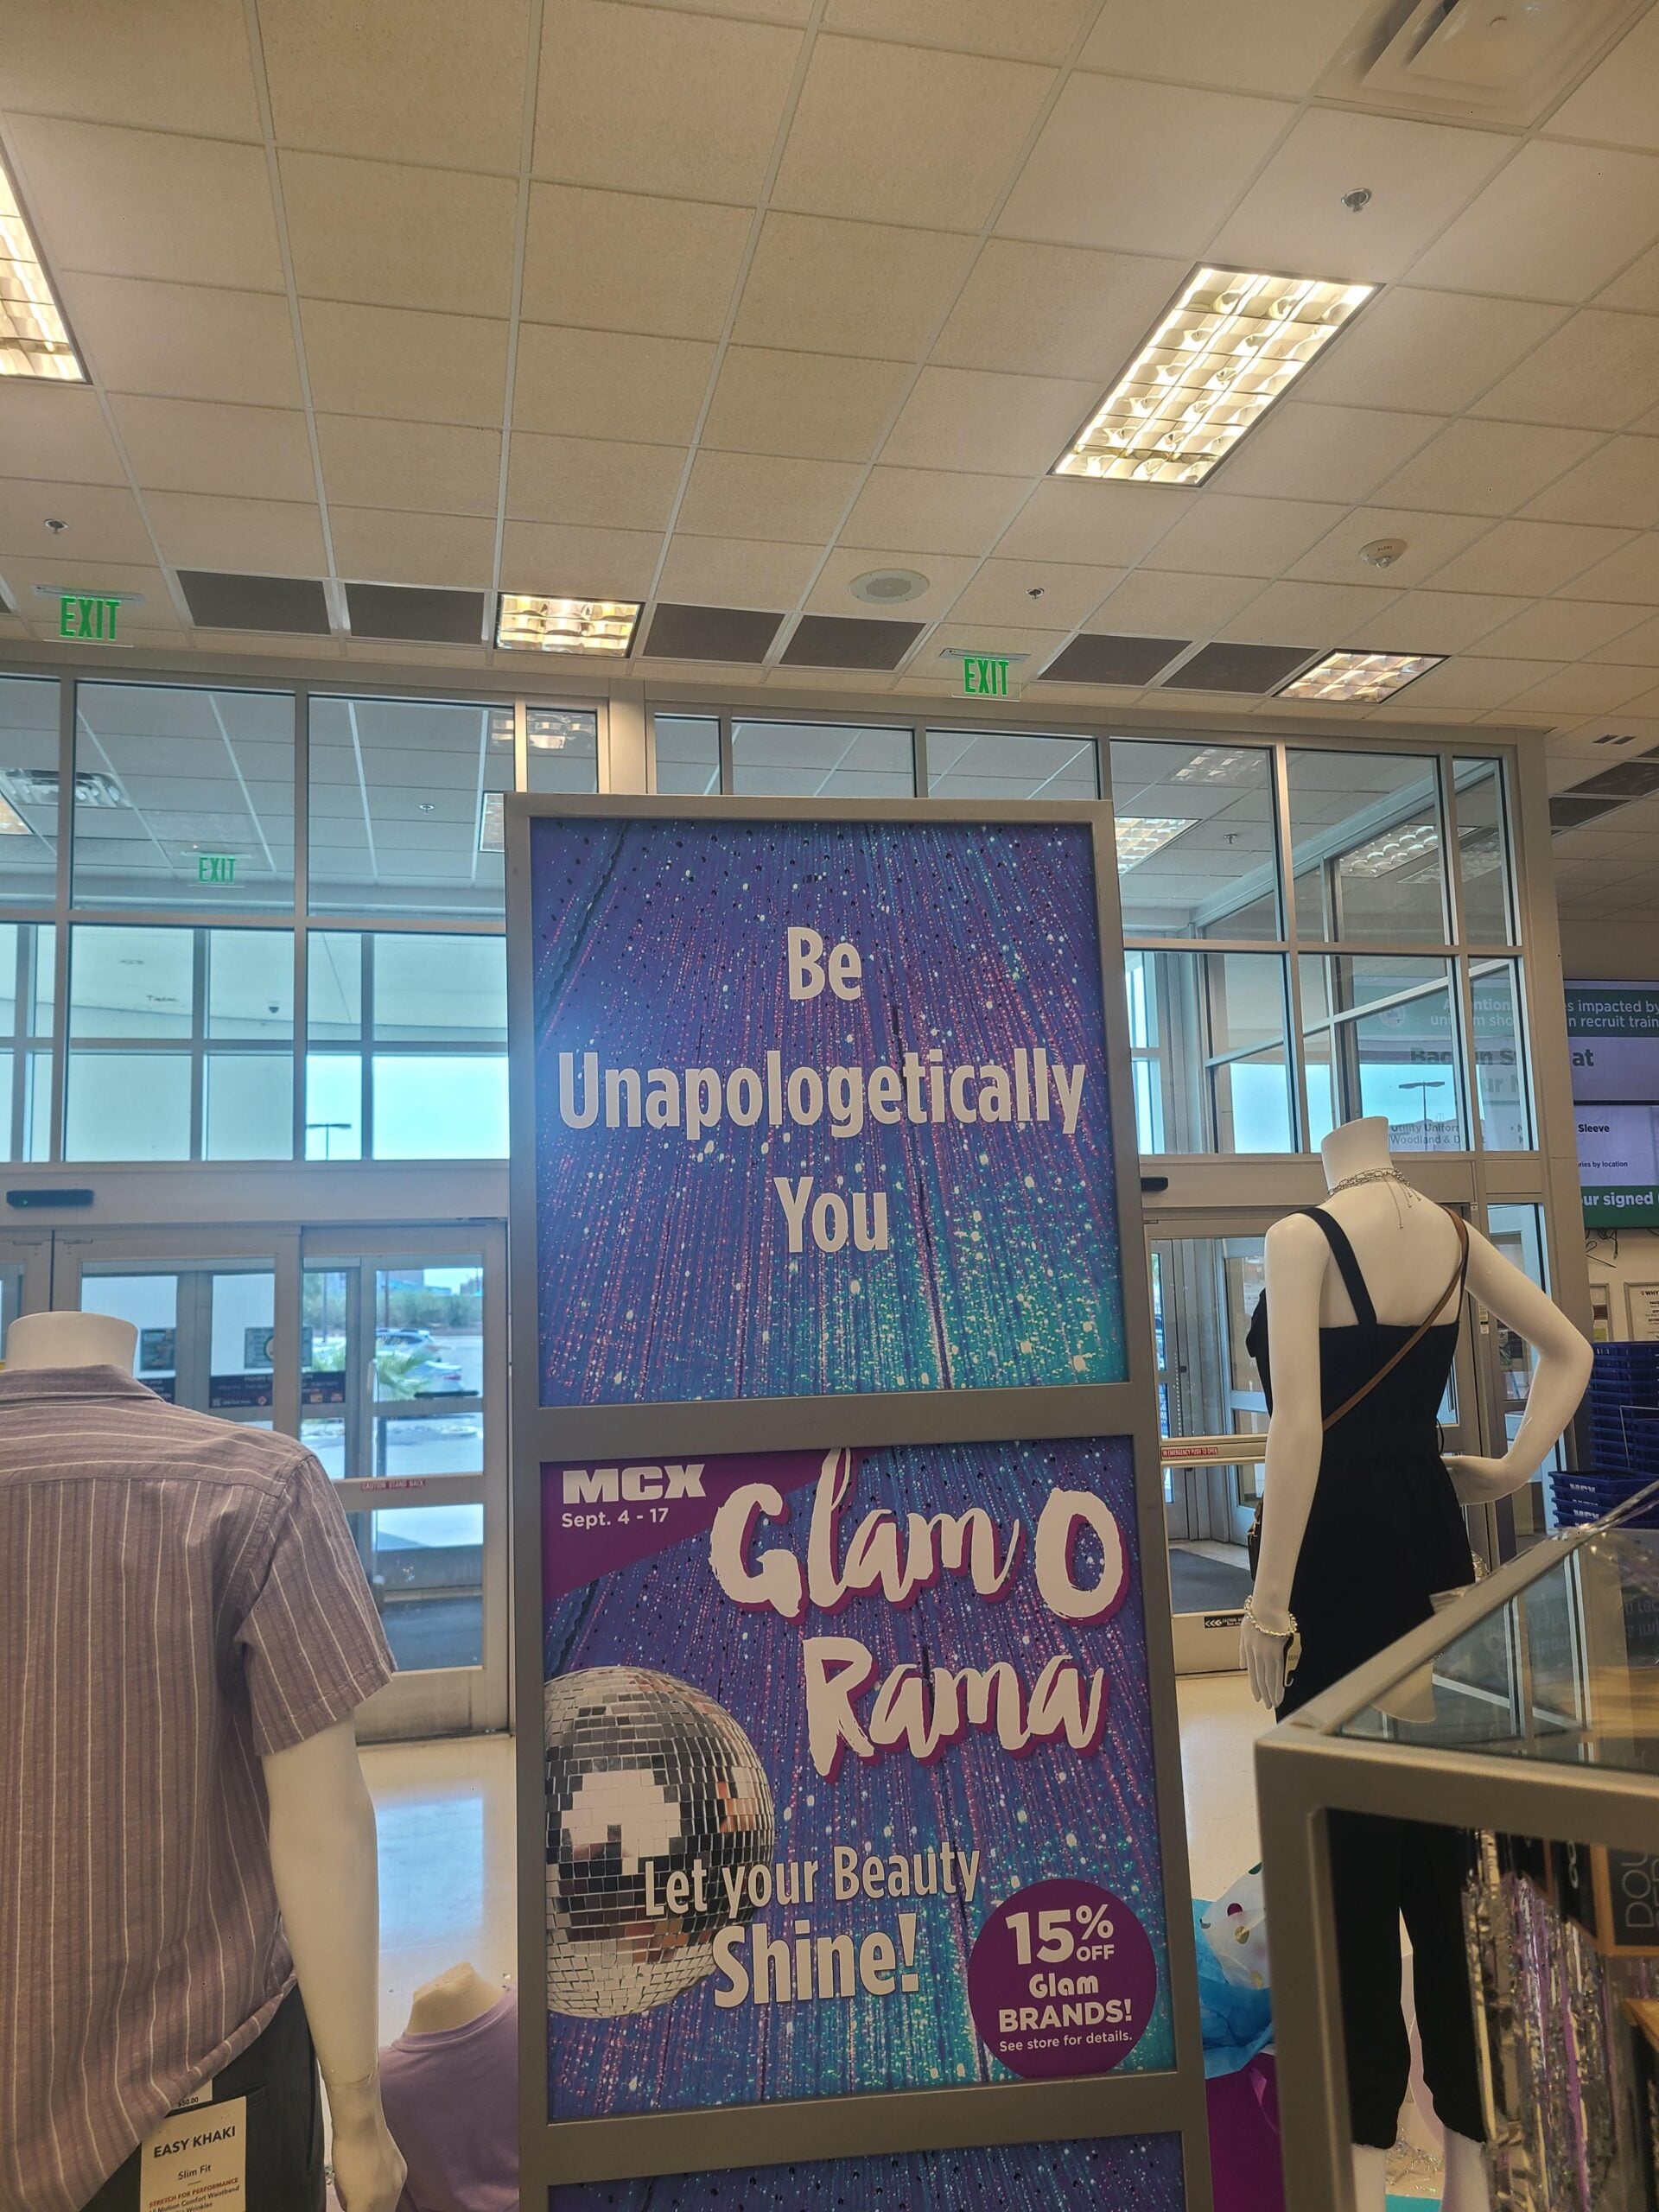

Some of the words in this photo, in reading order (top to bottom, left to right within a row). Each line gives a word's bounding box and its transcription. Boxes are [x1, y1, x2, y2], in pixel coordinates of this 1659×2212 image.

[60, 596, 122, 640] EXIT
[963, 657, 1009, 696] EXIT
[199, 855, 237, 885] EXIT
[787, 926, 861, 1001] Be
[1431, 1014, 1485, 1026] unim
[1580, 1015, 1625, 1027] recruit
[1578, 1000, 1642, 1014] impacted
[1573, 1049, 1594, 1066] at
[558, 1047, 1085, 1140] Unapologetically
[1390, 1135, 1440, 1144] Woodland
[1424, 1123, 1459, 1133] Unifor
[1578, 1124, 1610, 1133] Sleeve
[774, 1177, 888, 1253] You
[1603, 1192, 1654, 1208] signed
[563, 1464, 706, 1503] MCX
[562, 1511, 612, 1529] Sept.
[617, 1510, 631, 1525] 4
[649, 1507, 669, 1523] 17
[709, 1447, 1020, 1618] Glam
[1034, 1487, 1122, 1620] O
[803, 1637, 1104, 1777] Rama
[645, 1859, 708, 1916] Let
[721, 1859, 819, 1919] your
[833, 1841, 981, 1902] Beauty
[711, 1912, 920, 2008] Shine!
[1076, 1944, 1116, 1962] OFF
[1028, 1973, 1099, 1999] Glam
[999, 1999, 1133, 2033] BRANDS!
[999, 2040, 1024, 2052] See
[1027, 2037, 1060, 2049] store
[1063, 2034, 1083, 2046] for
[1086, 2031, 1133, 2044] details.
[154, 2138, 190, 2158] EASY
[193, 2126, 236, 2148] KHAKI
[178, 2166, 198, 2180] Slim
[200, 2164, 212, 2175] Fit
[149, 2196, 177, 2209] STRETCH
[178, 2191, 191, 2200] FOR
[192, 2177, 239, 2195] PERFORMANCE
[181, 2196, 207, 2207] Comfort
[208, 2185, 240, 2199] Waistband
